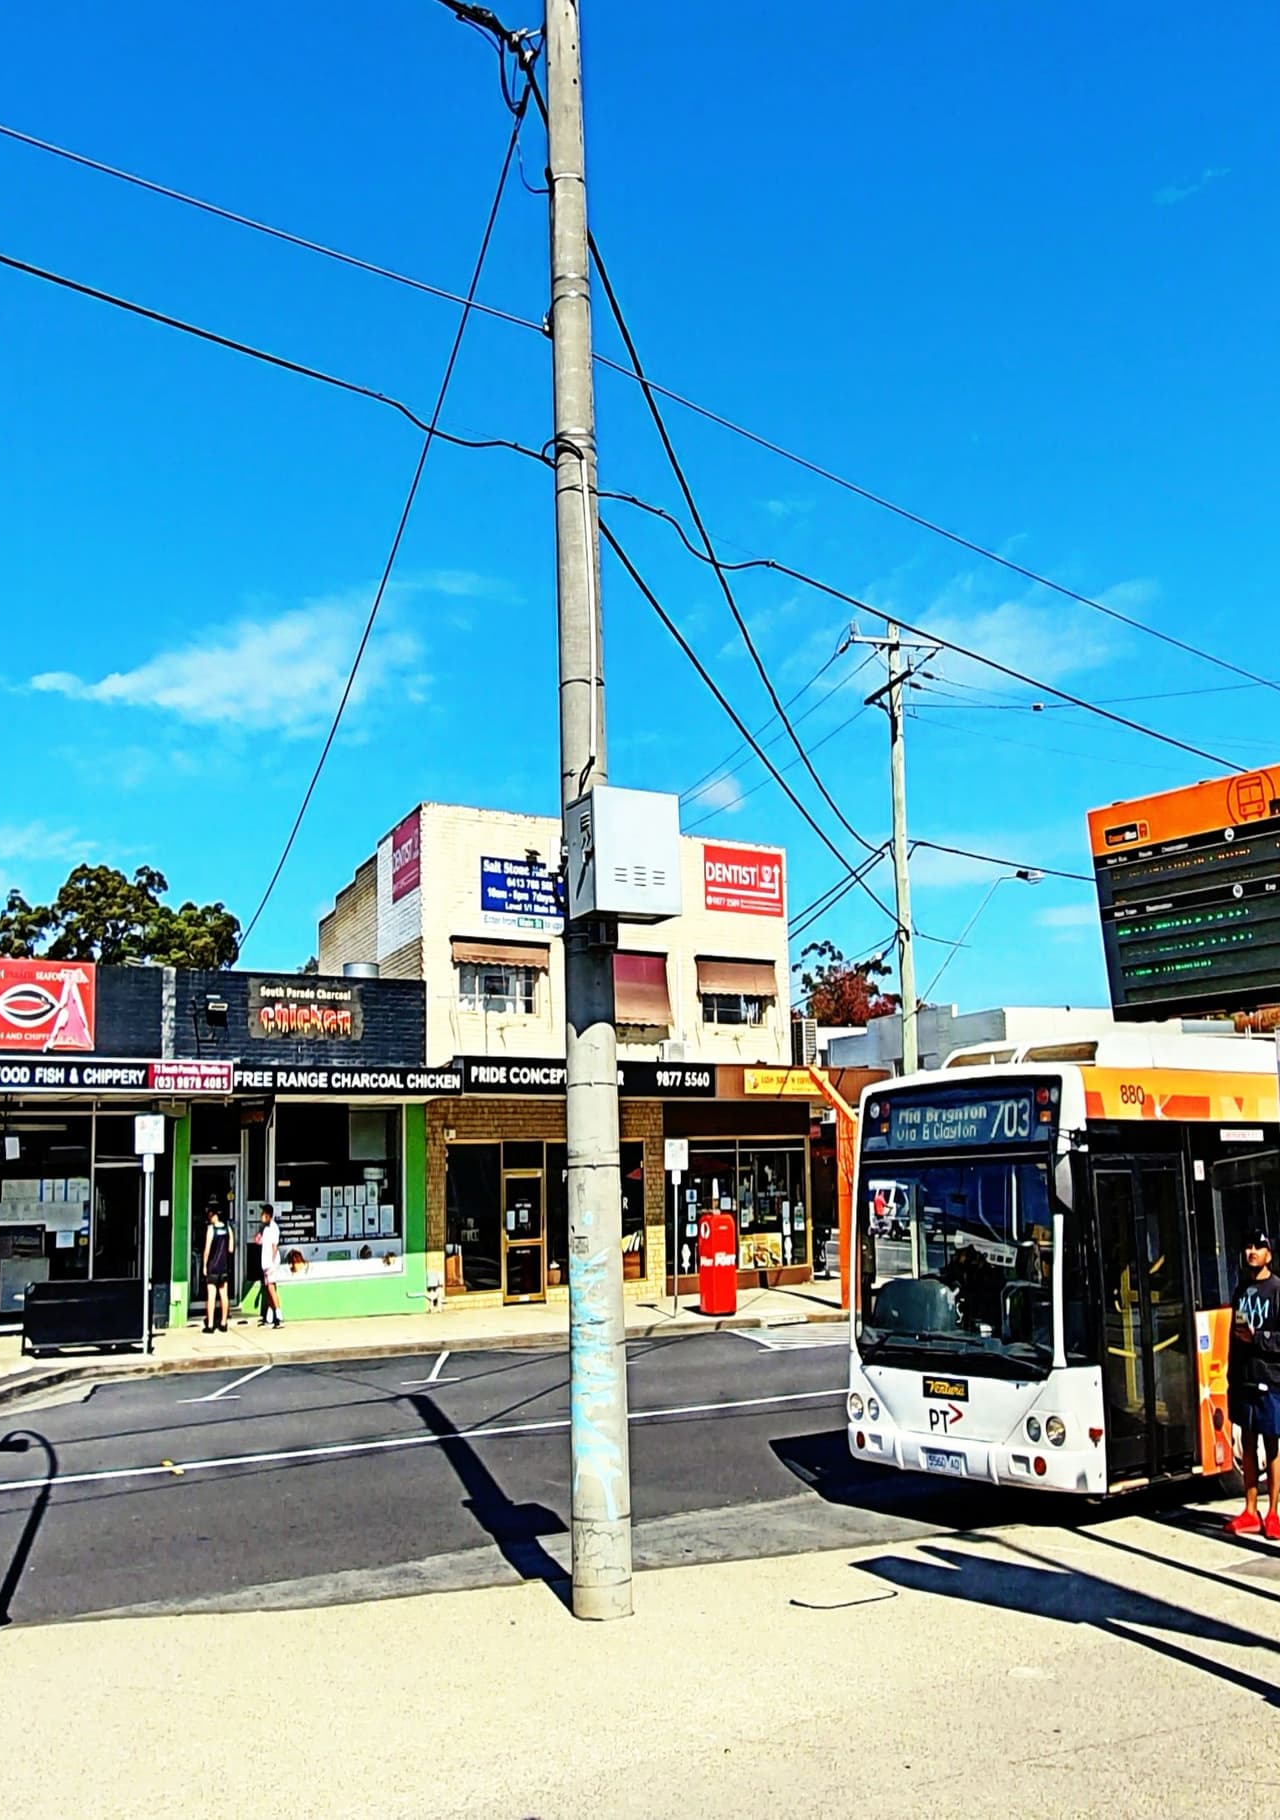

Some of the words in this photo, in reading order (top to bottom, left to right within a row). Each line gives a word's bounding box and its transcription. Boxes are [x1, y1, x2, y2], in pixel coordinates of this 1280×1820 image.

[483, 859, 502, 873] Salt
[705, 861, 757, 886] DENTIST
[260, 986, 284, 998] South
[286, 987, 315, 999] Parade
[317, 989, 352, 1000] Charcoal
[35, 1067, 65, 1084] FISH
[69, 1069, 79, 1084] &
[83, 1068, 146, 1085] CHIPPERY
[234, 1071, 273, 1087] FREE
[277, 1072, 328, 1088] RANGE
[331, 1072, 404, 1089] CHARCOAL
[407, 1073, 461, 1089] CHICKEN
[470, 1066, 507, 1084] PRIDE
[656, 1069, 681, 1086] 9877
[684, 1071, 710, 1088] 5560
[1120, 1084, 1145, 1105] 880
[898, 1109, 922, 1125] Mid
[925, 1104, 987, 1124] Brighton
[990, 1098, 1031, 1139] 703
[933, 1123, 978, 1140] Clayton
